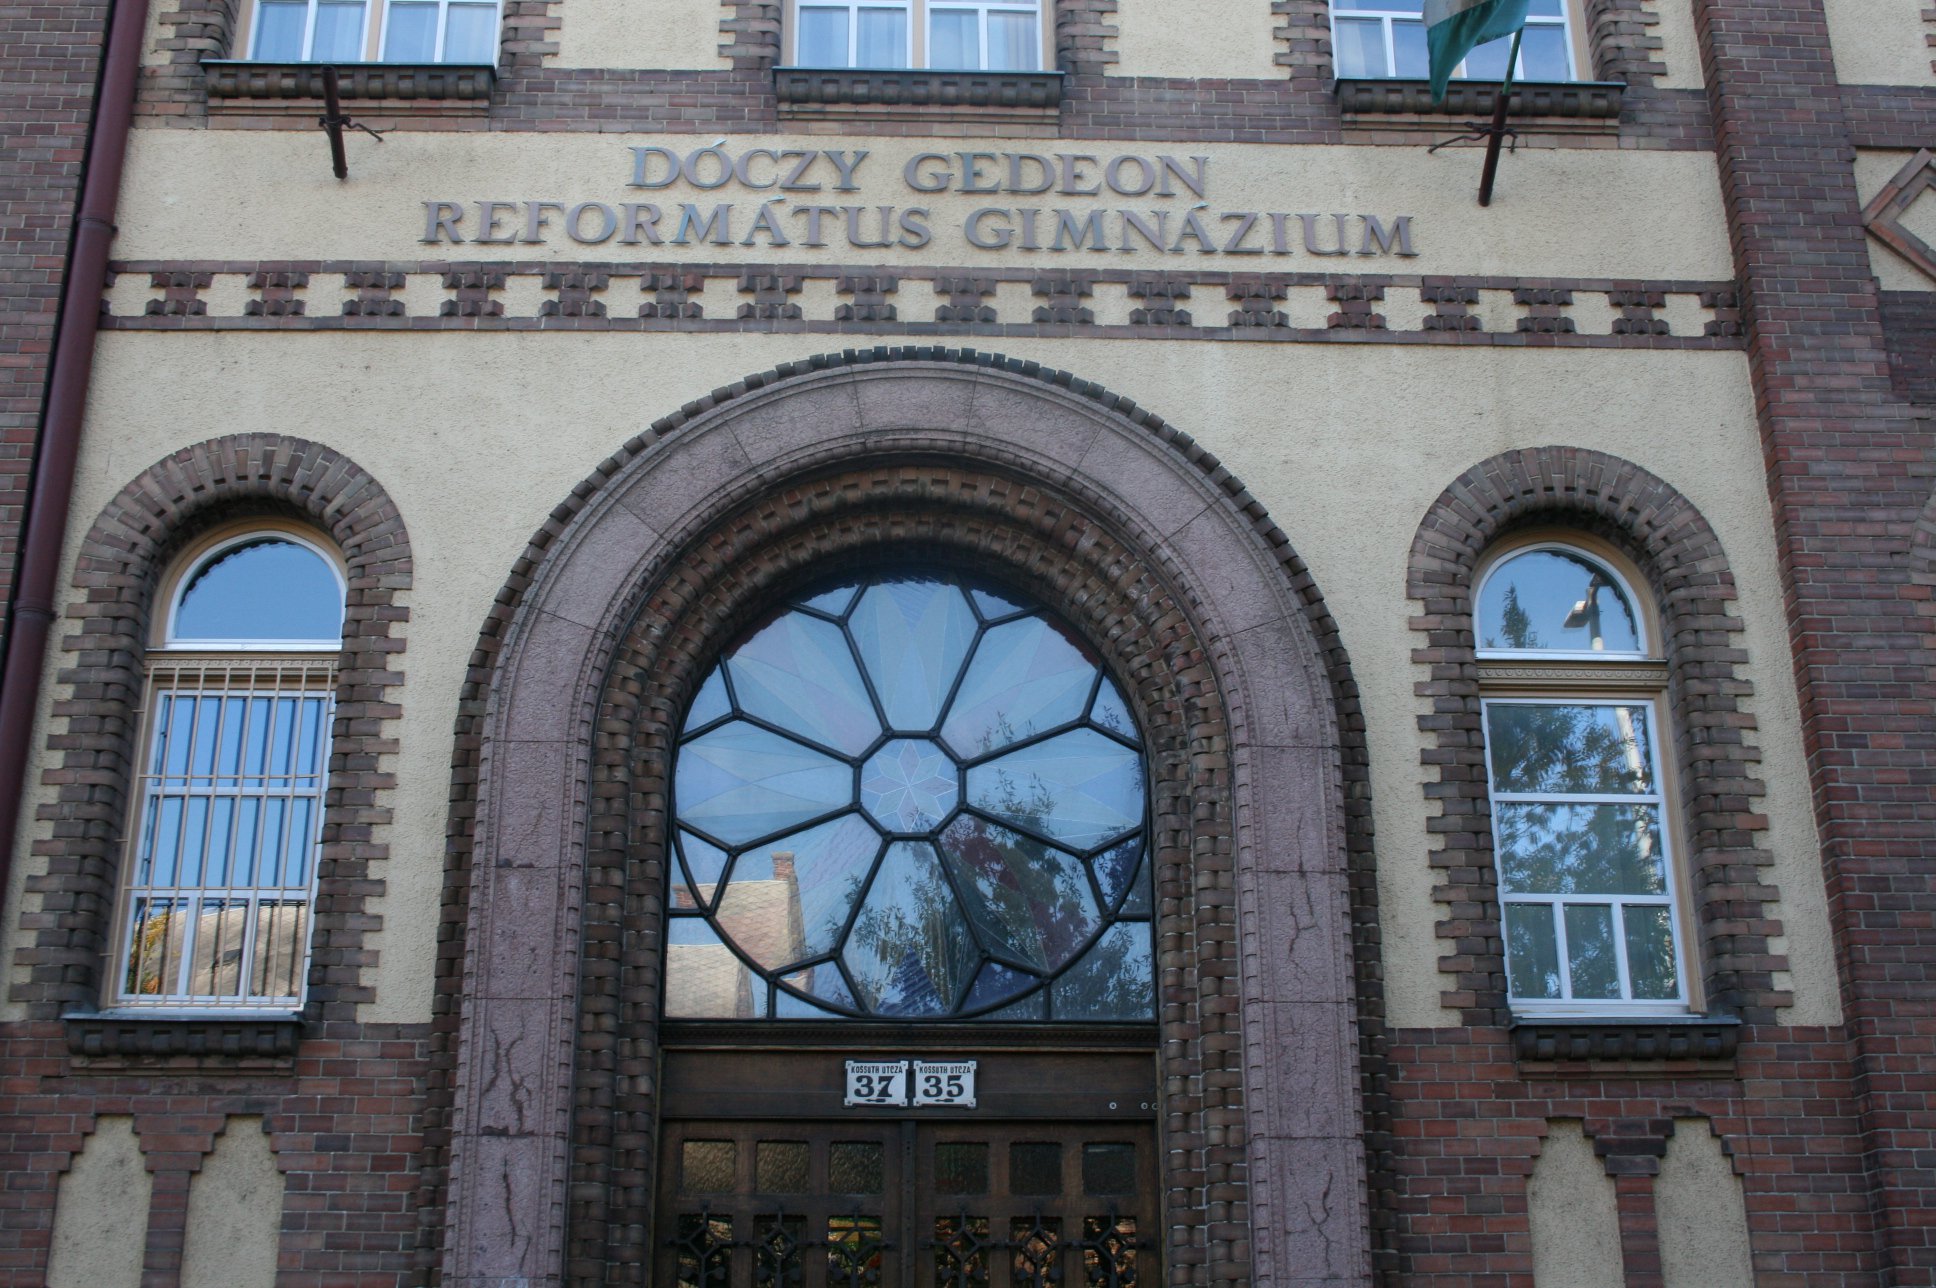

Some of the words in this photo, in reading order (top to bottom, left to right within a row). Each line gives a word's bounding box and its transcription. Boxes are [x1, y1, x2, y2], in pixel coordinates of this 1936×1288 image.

[625, 138, 870, 191] DÓCZY
[904, 151, 1209, 199] GEDEON
[417, 195, 932, 248] REFORMÁTUS
[964, 202, 1420, 257] GIMNÁZIUM
[851, 1065, 880, 1074] KOSSUTH
[882, 1065, 903, 1074] UTCZA
[919, 1065, 948, 1074] KOSSUTH
[950, 1065, 971, 1074] UTCZA
[854, 1075, 895, 1098] 37
[922, 1075, 964, 1098] 35
